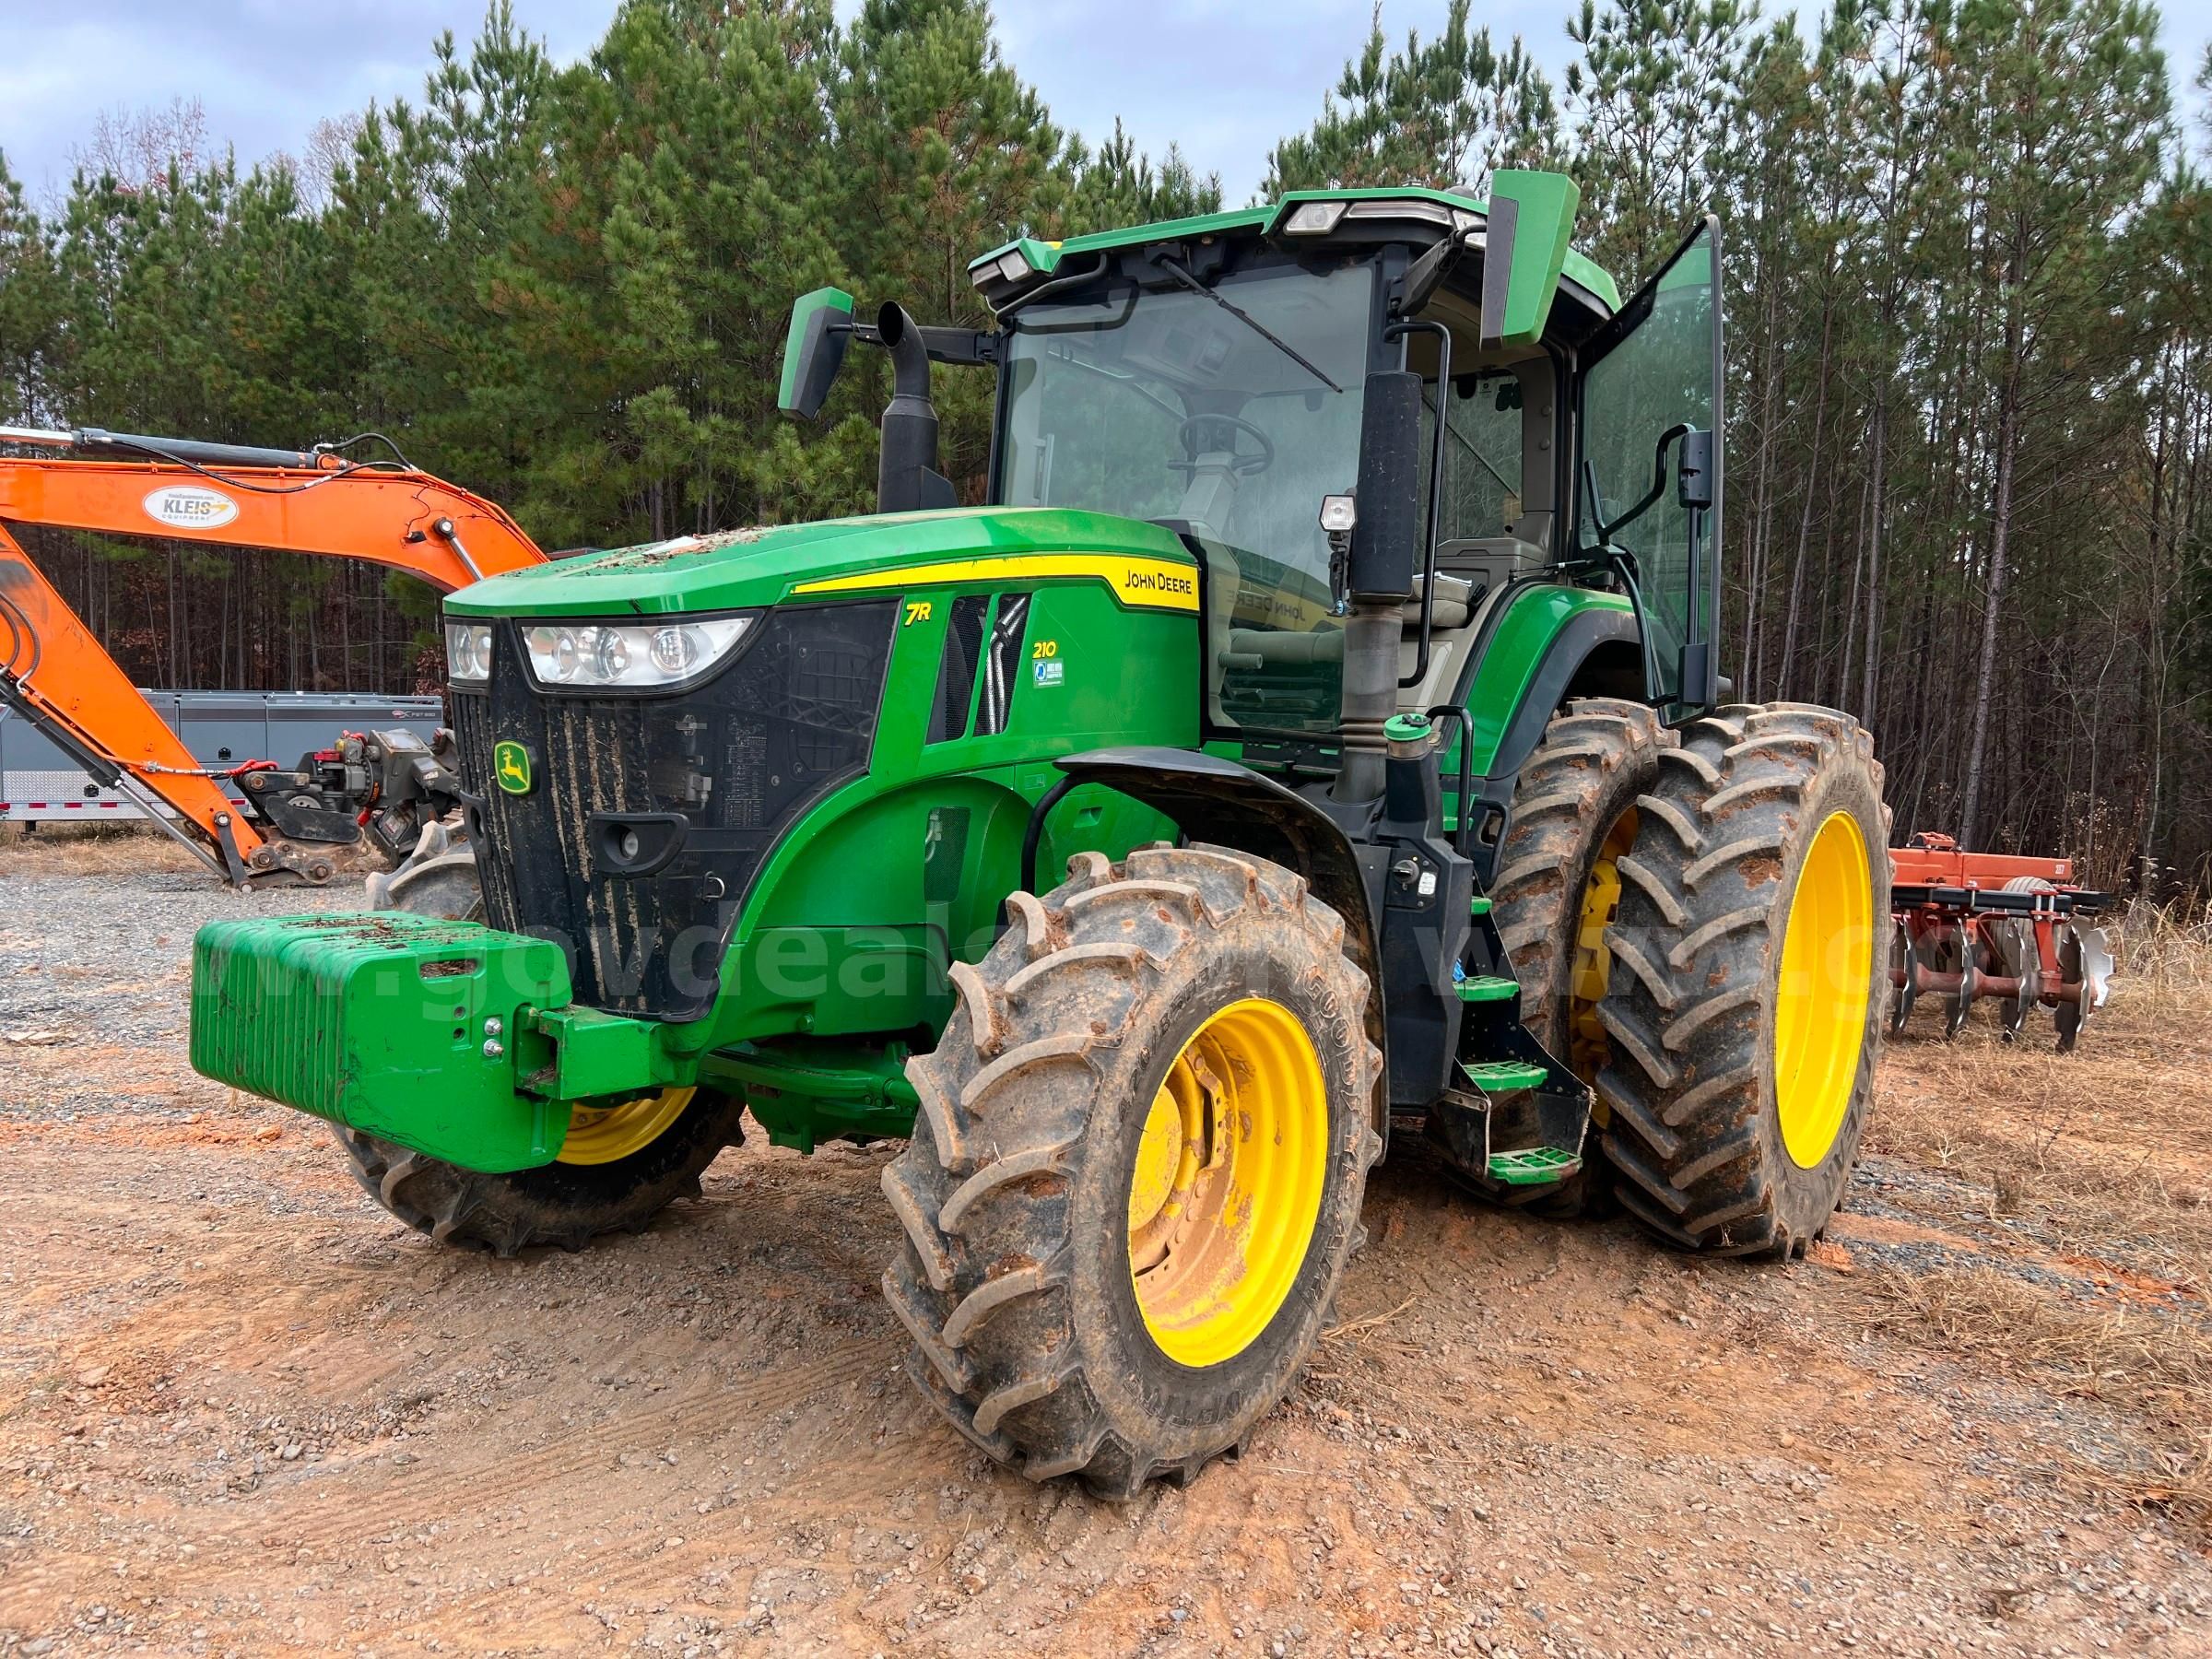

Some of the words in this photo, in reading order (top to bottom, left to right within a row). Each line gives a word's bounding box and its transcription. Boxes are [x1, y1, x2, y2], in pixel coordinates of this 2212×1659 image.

[163, 499, 211, 515] KLEIS
[1124, 569, 1156, 590] JOHN
[1158, 572, 1192, 594] DEERE
[904, 602, 932, 627] 7R
[1032, 640, 1057, 659] 210
